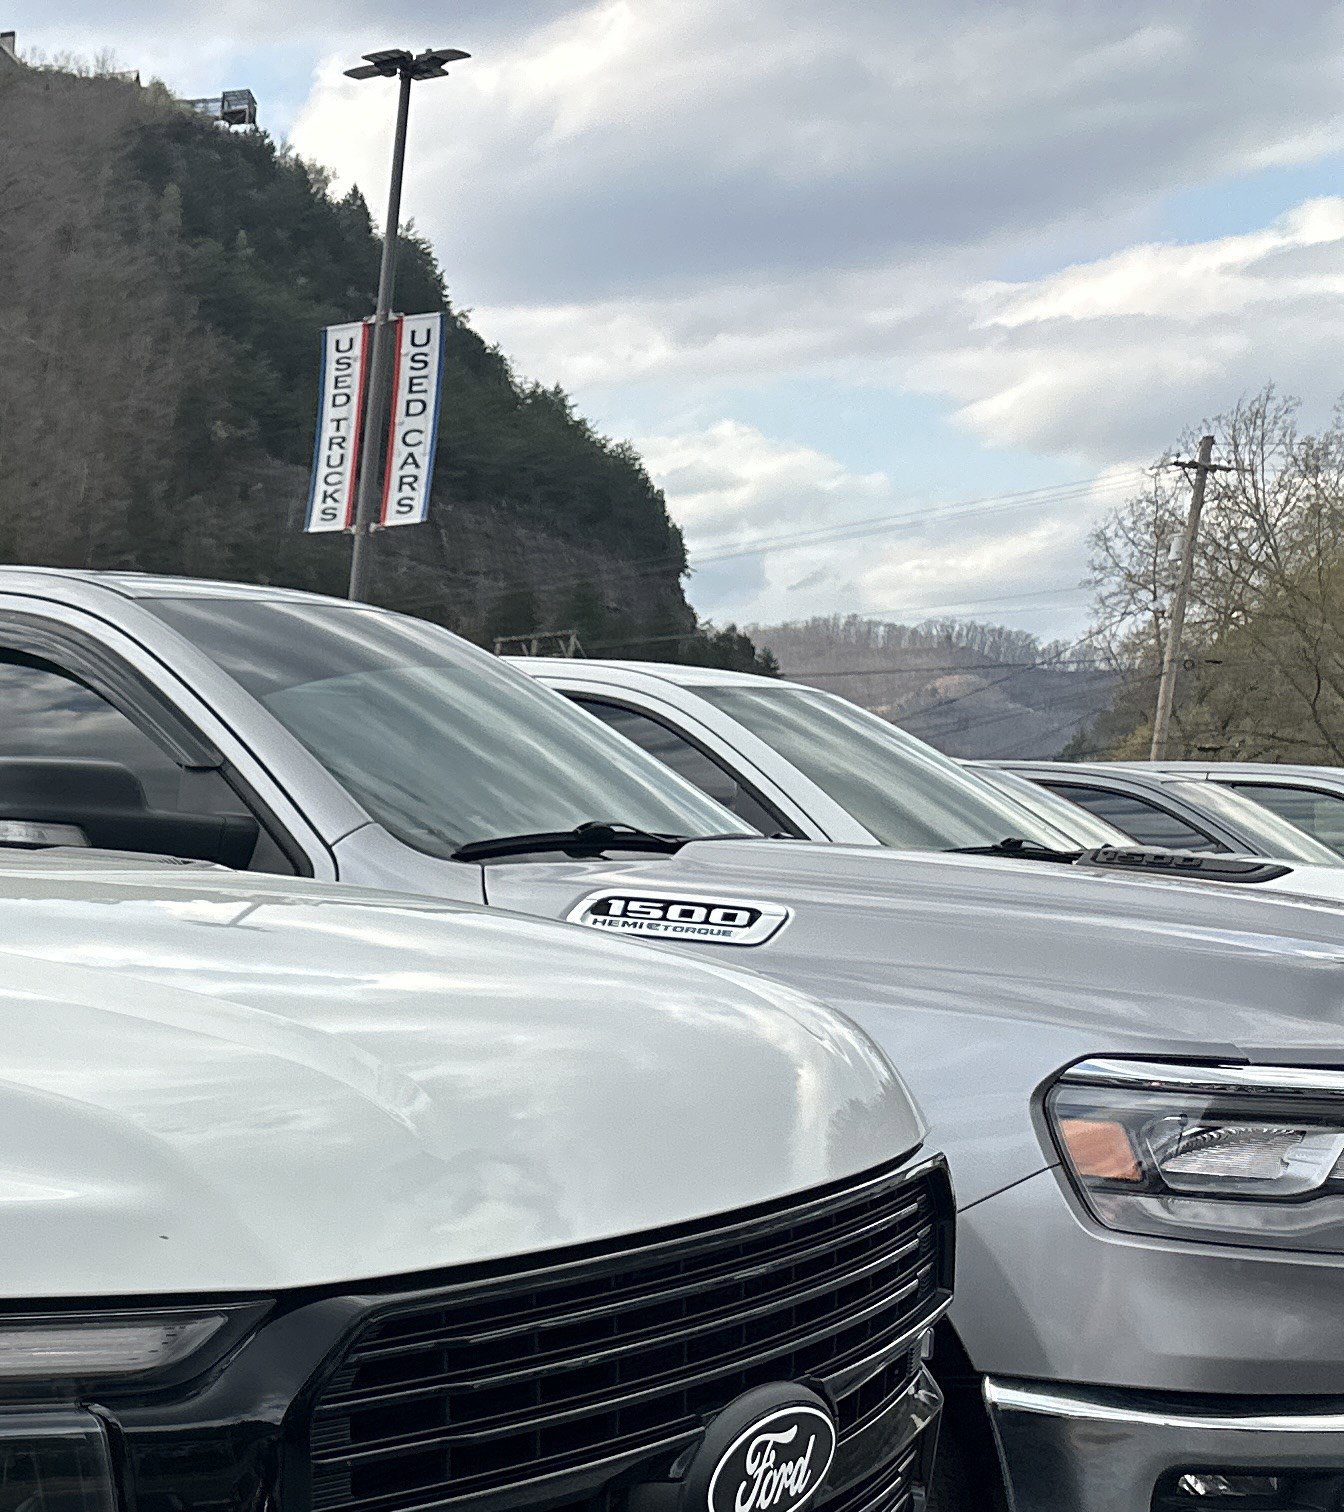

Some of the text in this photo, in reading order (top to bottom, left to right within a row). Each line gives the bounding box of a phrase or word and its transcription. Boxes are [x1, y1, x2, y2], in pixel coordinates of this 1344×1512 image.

[320, 337, 354, 522] USED TRUCKS
[396, 328, 431, 515] USED CARS
[592, 917, 644, 930] HEMI
[607, 899, 752, 927] 1500
